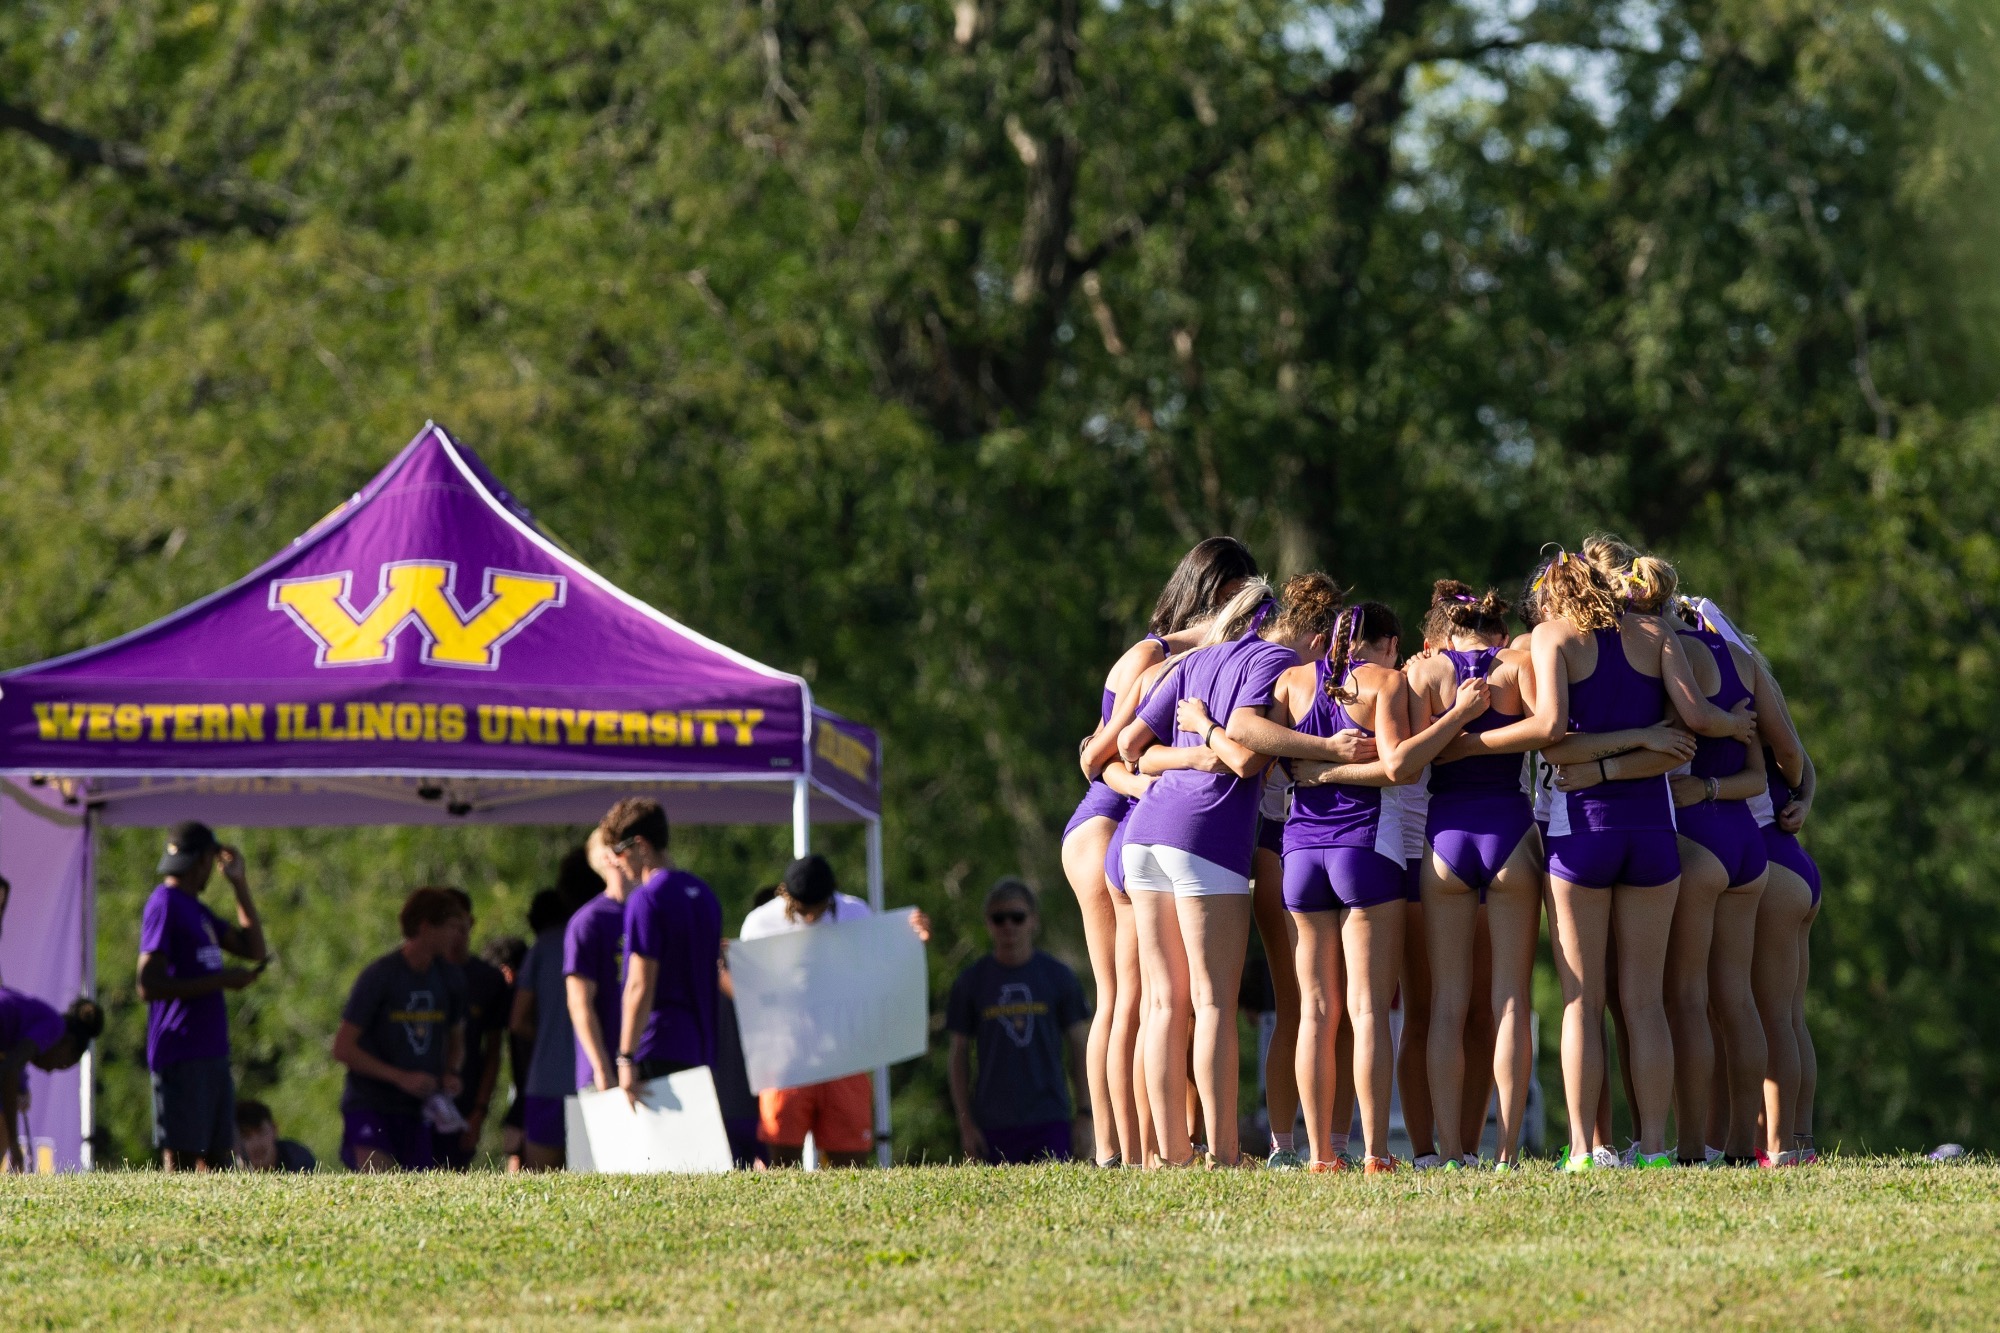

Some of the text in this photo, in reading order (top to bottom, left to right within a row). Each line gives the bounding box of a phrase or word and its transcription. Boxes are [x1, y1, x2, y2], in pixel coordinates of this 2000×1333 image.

[268, 559, 568, 671] W
[33, 702, 765, 747] WESTERN ILLINOIS UNIVERSITY
